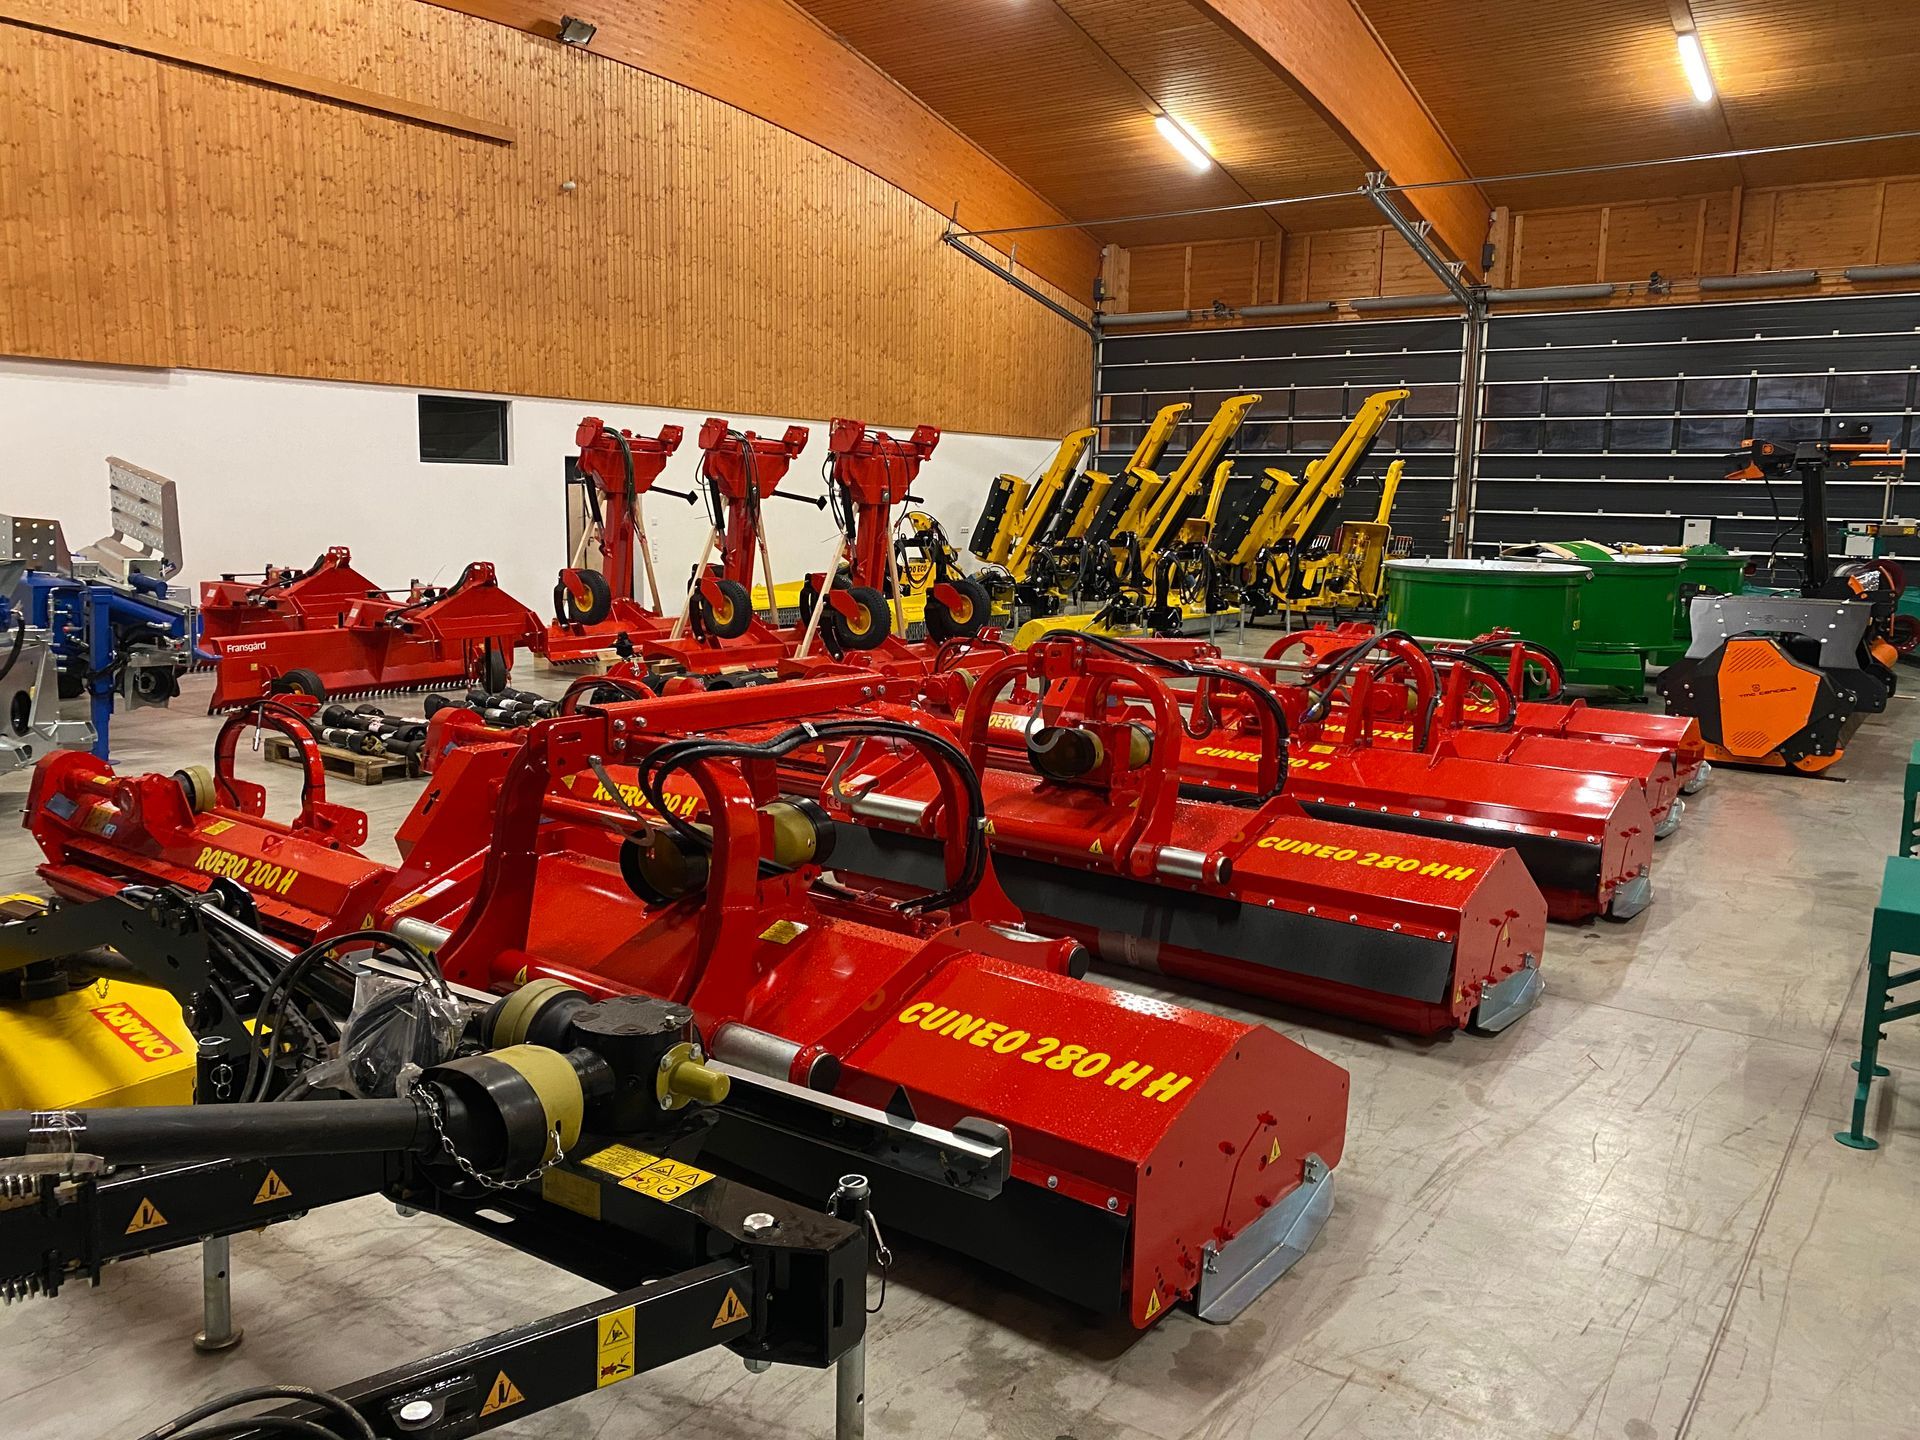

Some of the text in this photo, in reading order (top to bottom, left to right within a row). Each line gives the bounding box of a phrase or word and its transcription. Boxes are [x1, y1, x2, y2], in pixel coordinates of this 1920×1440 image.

[988, 714, 1019, 730] OERO
[1308, 761, 1332, 770] H
[680, 796, 698, 816] H
[194, 847, 299, 895] ROERO 200 H
[1257, 836, 1358, 861] CUNEO
[1356, 852, 1420, 872] 280
[97, 1007, 173, 1058] OMARV
[898, 1002, 1031, 1054] CUNEO
[1021, 1037, 1111, 1078] 280
